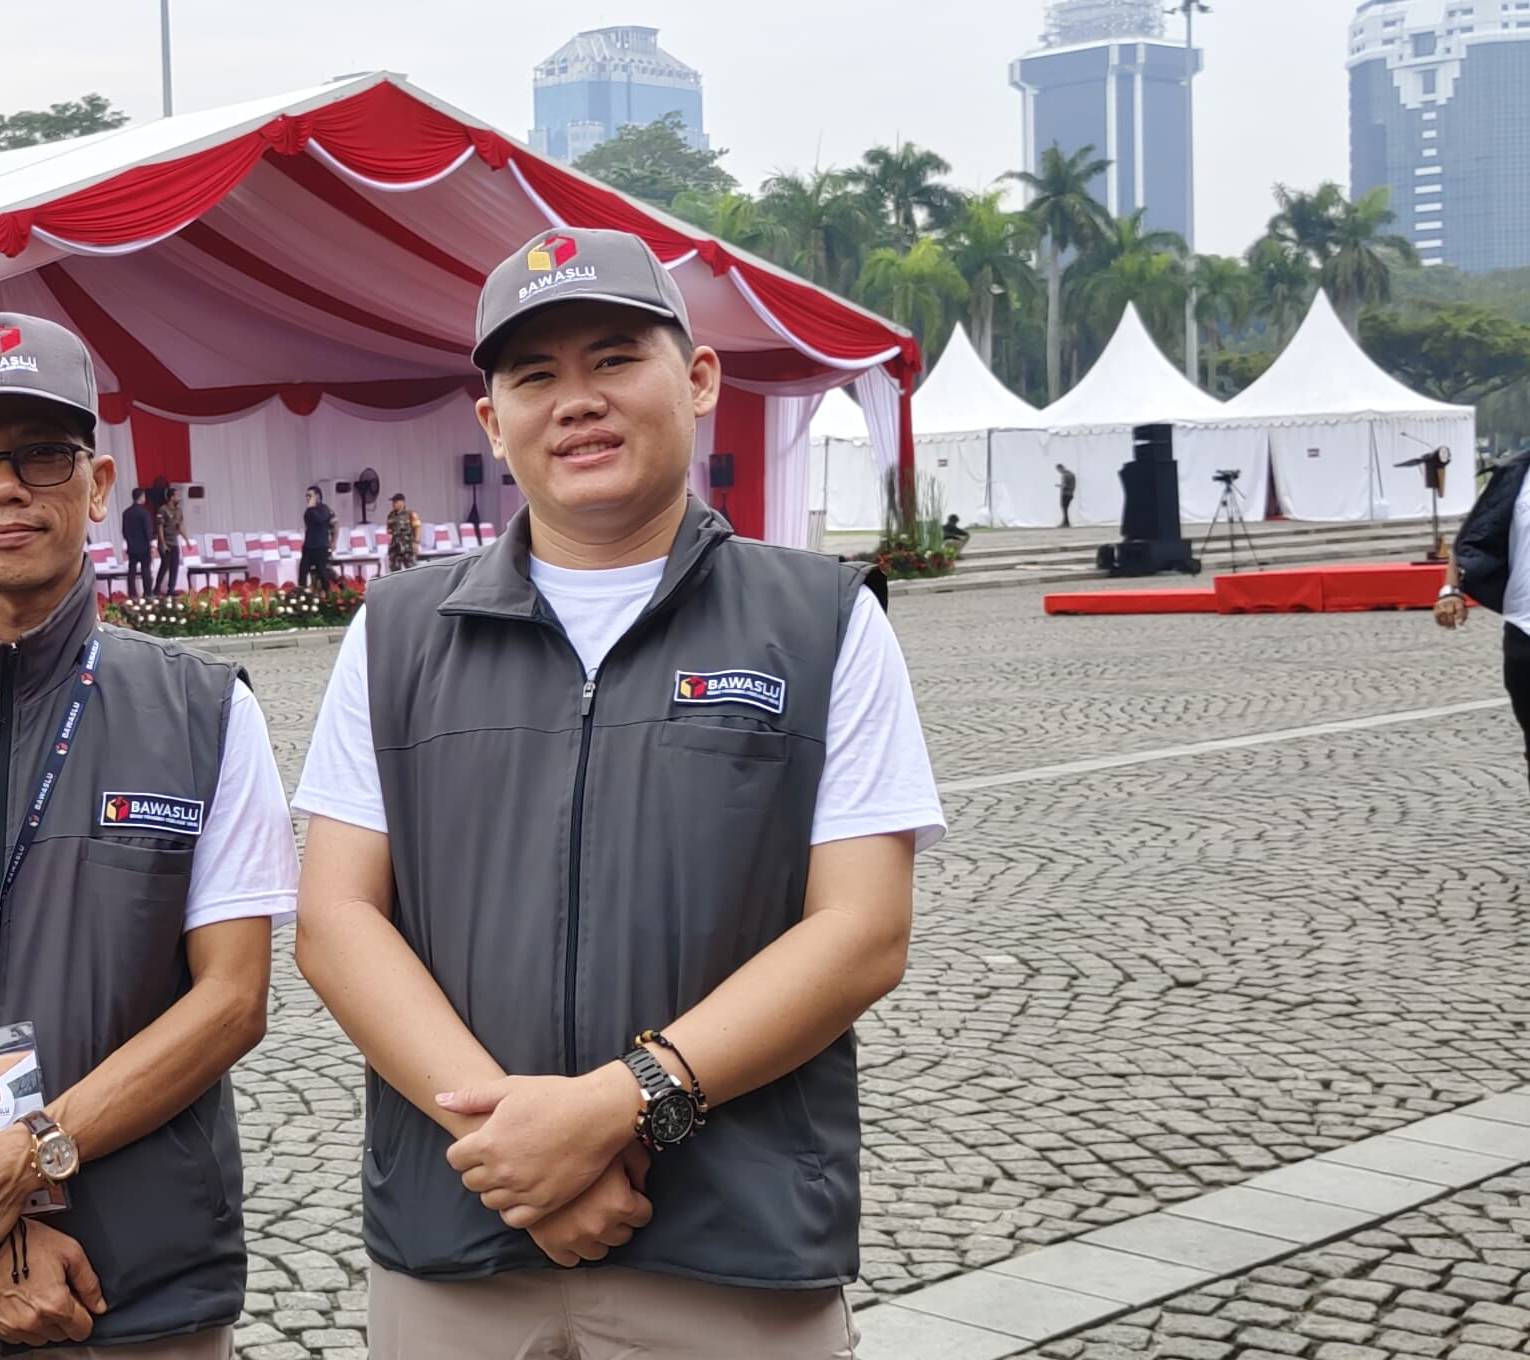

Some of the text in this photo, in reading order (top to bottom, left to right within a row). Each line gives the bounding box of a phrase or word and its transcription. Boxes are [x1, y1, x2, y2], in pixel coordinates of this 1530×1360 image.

[518, 265, 596, 299] BAWASLU
[708, 677, 780, 698] BAWASLU
[34, 772, 54, 810] BAWASLU
[130, 800, 199, 821] BAWASLU
